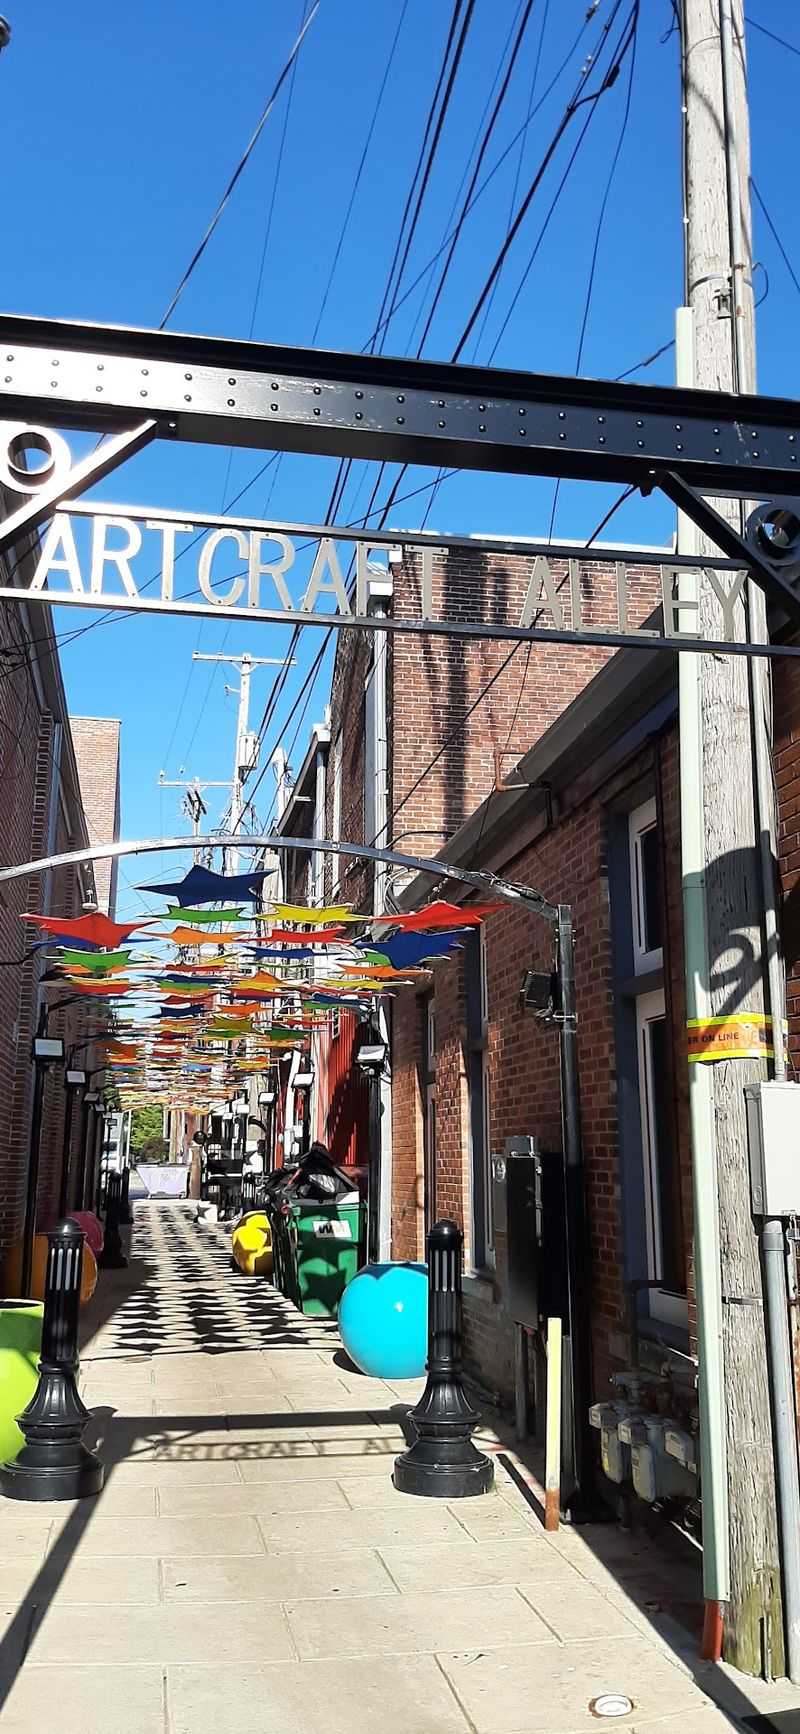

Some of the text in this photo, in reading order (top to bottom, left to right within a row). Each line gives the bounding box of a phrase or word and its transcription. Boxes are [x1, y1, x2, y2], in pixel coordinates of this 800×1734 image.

[29, 512, 748, 642] ARTCRAFT ALLEY
[718, 1032, 739, 1042] LINE
